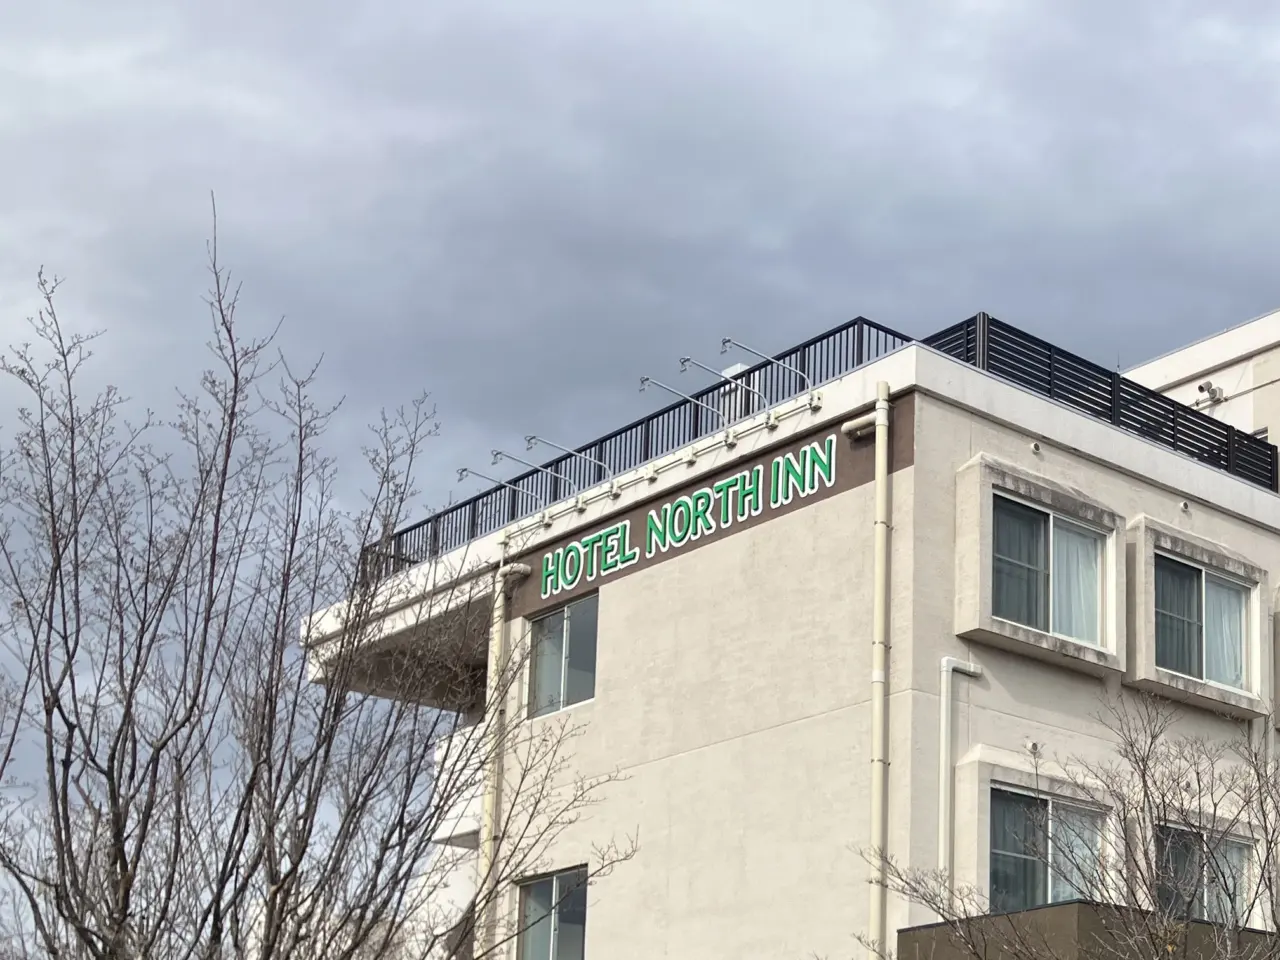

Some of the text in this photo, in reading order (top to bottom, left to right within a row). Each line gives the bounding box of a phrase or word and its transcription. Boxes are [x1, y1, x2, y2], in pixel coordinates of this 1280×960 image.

[541, 434, 836, 599] HOTEL NORTH INN
